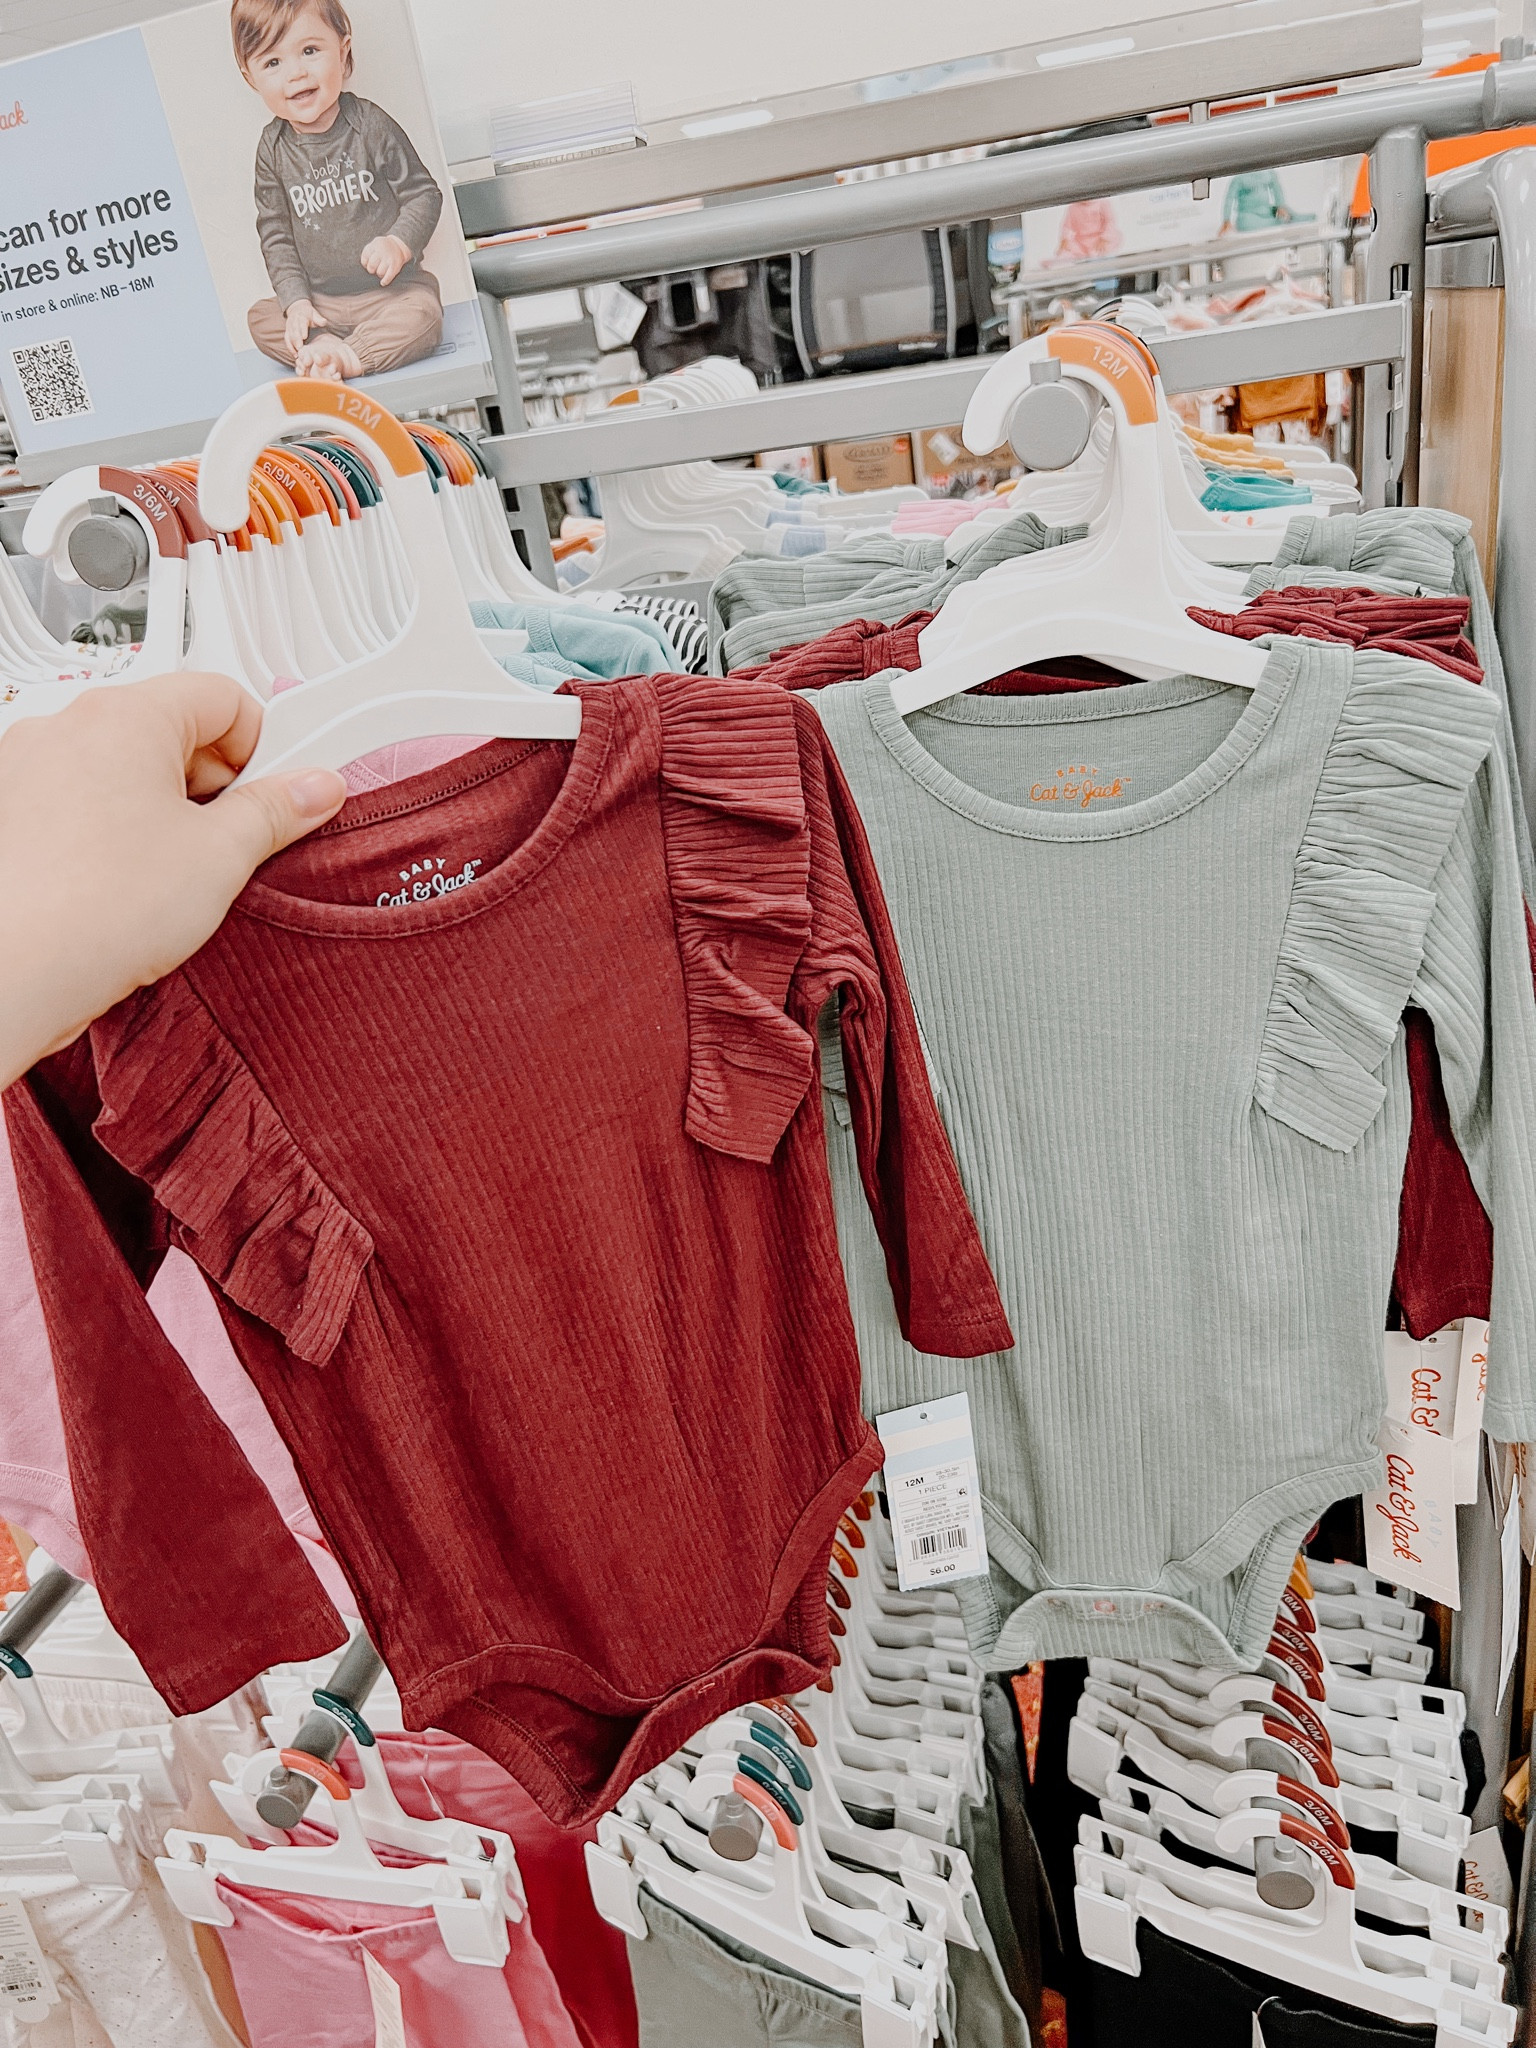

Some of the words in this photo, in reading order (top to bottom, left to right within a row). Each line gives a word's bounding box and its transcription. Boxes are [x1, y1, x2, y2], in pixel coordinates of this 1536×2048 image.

[0, 101, 29, 130] ack
[308, 156, 341, 180] baby
[289, 170, 380, 217] BROTHER
[0, 221, 45, 252] can
[48, 209, 89, 238] for
[96, 189, 171, 227] more
[0, 258, 60, 294] sizes
[65, 245, 90, 275] &
[93, 229, 179, 269] styles
[1, 311, 14, 323] in
[15, 304, 47, 320] store
[48, 299, 59, 312] &
[60, 292, 99, 309] online:
[1092, 345, 1129, 380] 12M
[336, 393, 383, 430] 12M
[263, 461, 297, 491] 6/9M
[133, 484, 168, 521] 3/6M
[1056, 765, 1099, 778] BABY
[1030, 783, 1059, 801] Cat
[1063, 782, 1080, 800] &
[399, 858, 447, 882] BABY
[412, 881, 432, 902] &
[1410, 1368, 1442, 1403] Cat
[1410, 1406, 1440, 1425] &
[905, 1477, 924, 1488] 12M
[1386, 1453, 1415, 1492] Cat
[924, 1483, 948, 1493] PIECE
[1388, 1491, 1416, 1517] &
[1375, 1503, 1422, 1565] Jack
[1421, 1500, 1443, 1549] BABY
[929, 1563, 956, 1576] $6.00
[1298, 1713, 1324, 1742] 3/6M
[1289, 1737, 1320, 1764] 3/6M
[1304, 1799, 1334, 1827] 3/6M
[1308, 1839, 1341, 1866] 3/6M
